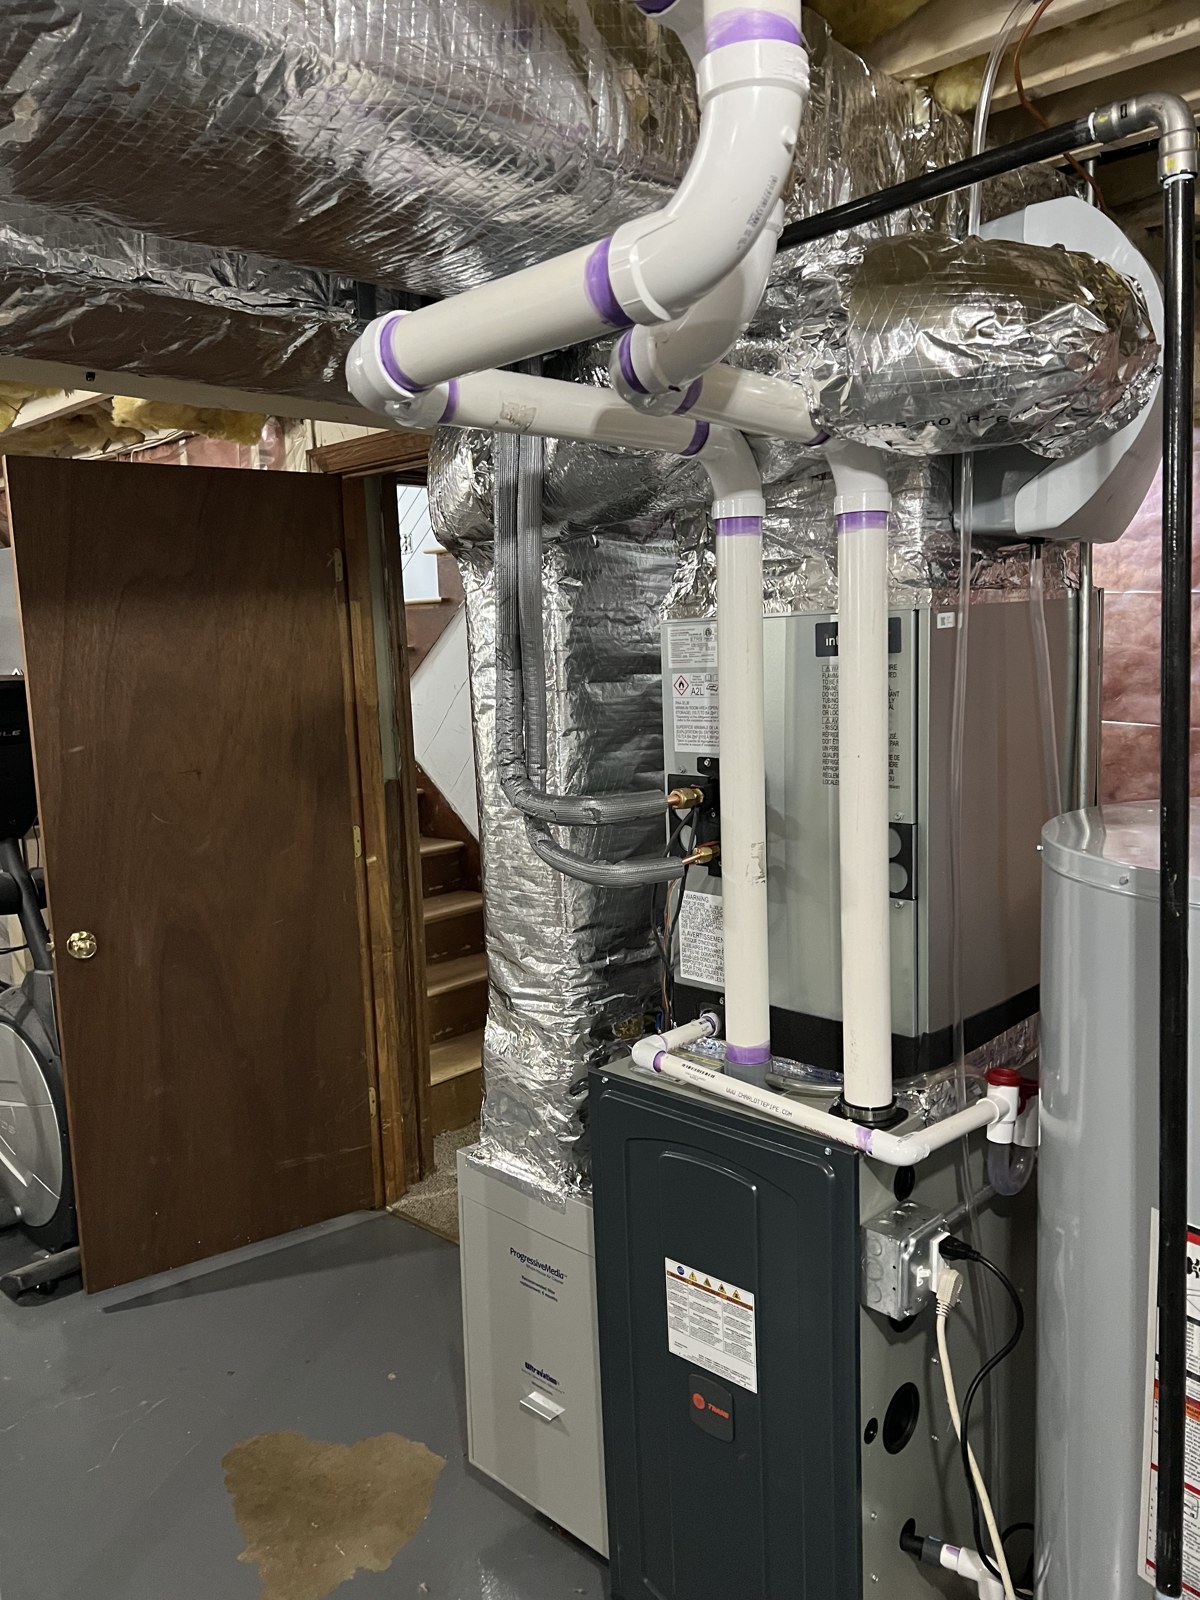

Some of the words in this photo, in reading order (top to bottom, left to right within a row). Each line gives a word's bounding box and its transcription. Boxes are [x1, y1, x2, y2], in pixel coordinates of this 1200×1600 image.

[691, 687, 704, 696] A2L
[686, 894, 709, 903] WARNING
[726, 1087, 793, 1117] WWW.CHARLOTTEPIPE.COM
[510, 1247, 564, 1279] ProgressiveMedia
